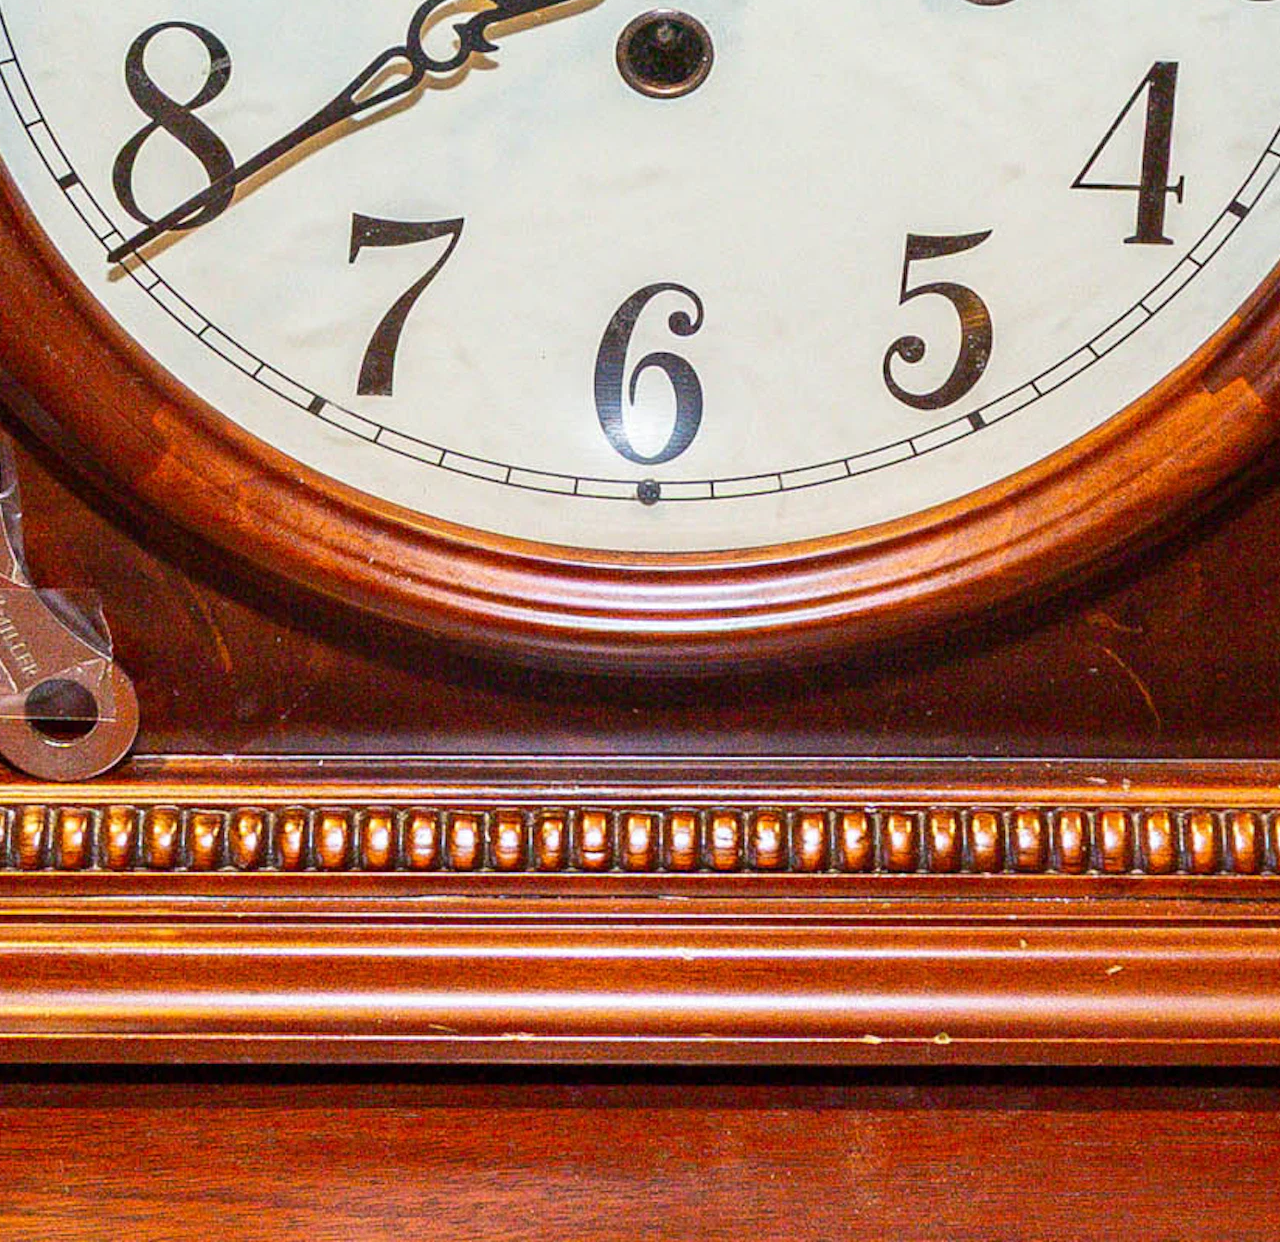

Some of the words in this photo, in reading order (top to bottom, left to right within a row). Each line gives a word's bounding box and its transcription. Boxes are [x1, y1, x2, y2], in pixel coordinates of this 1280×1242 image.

[111, 21, 236, 232] 8
[1070, 61, 1185, 245] 4
[348, 212, 465, 396] 7
[593, 282, 704, 466] 6
[882, 228, 994, 410] 5
